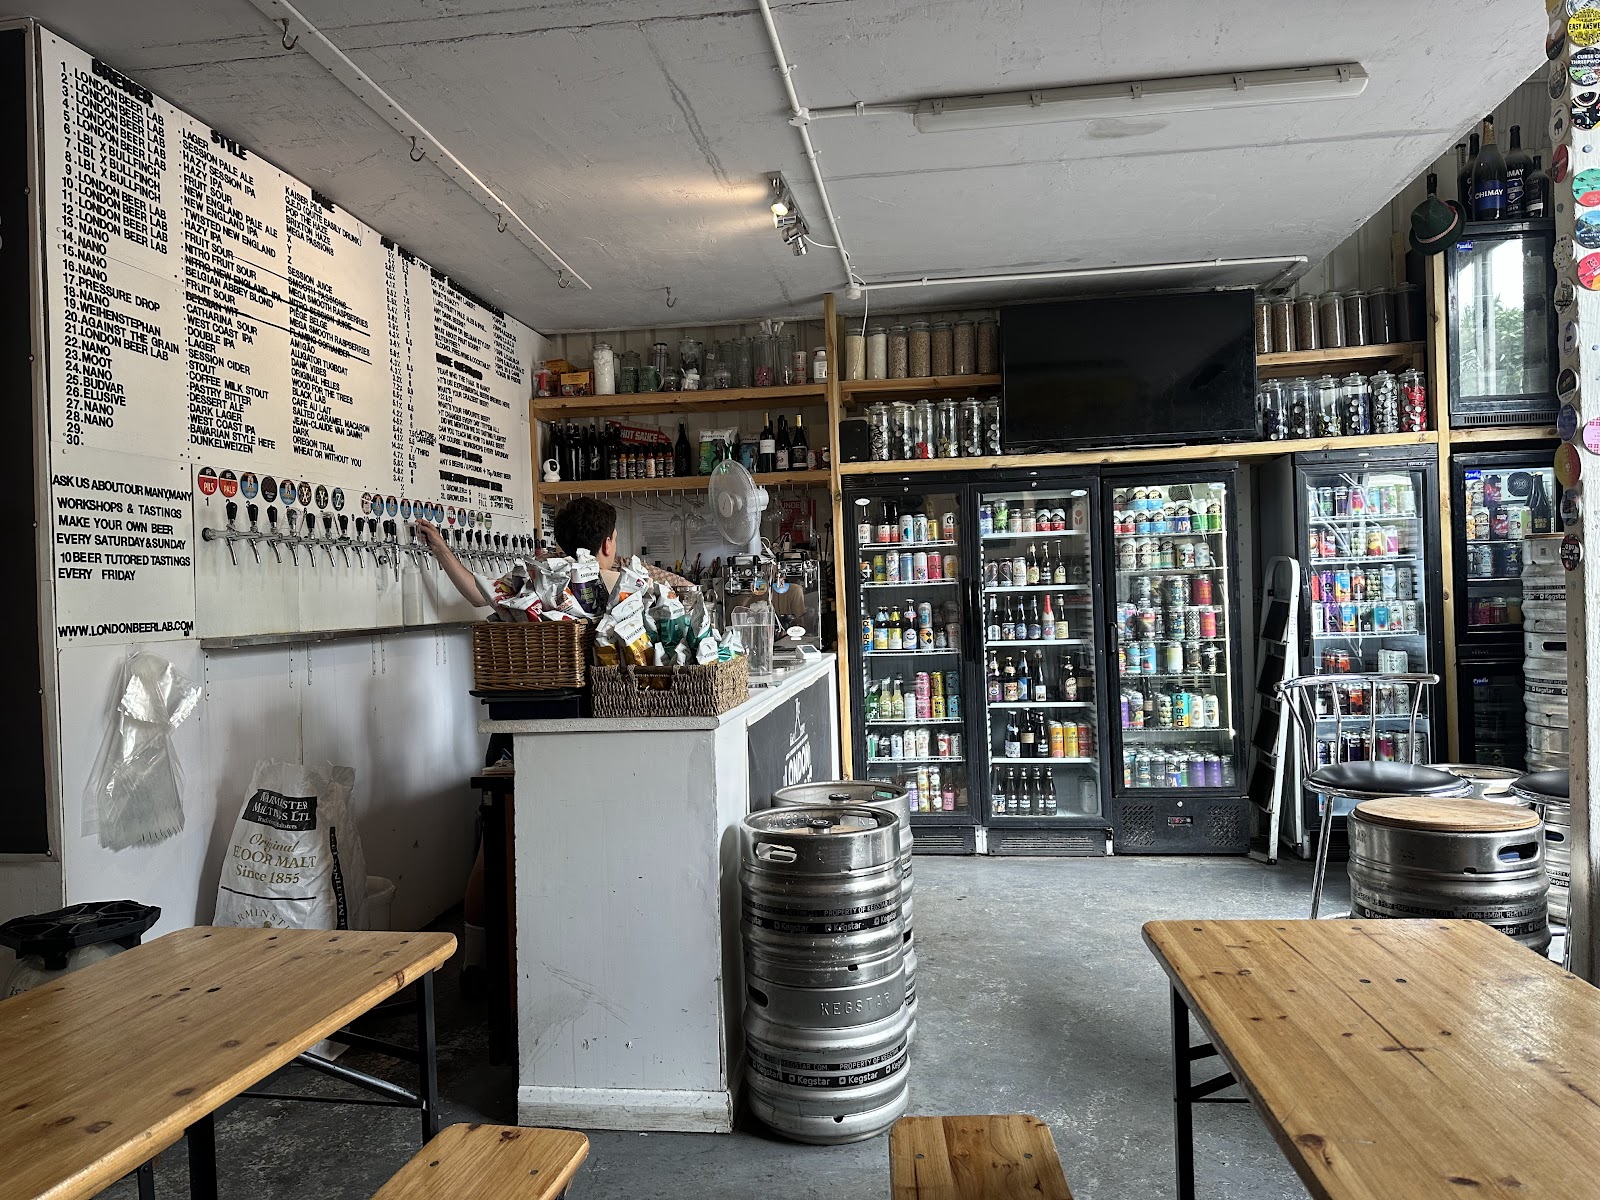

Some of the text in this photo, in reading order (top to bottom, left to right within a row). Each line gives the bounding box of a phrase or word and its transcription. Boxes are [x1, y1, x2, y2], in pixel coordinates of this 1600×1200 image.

[92, 58, 153, 108] BREWER
[75, 68, 164, 126] LONDON BEER LAB
[76, 79, 164, 137] LONDON BEER LAB
[76, 92, 165, 148] LONDON BEER LAB
[77, 103, 166, 159] LONDON BEER LAB
[77, 115, 166, 171] LONDON BEER LAB
[183, 128, 208, 150] LAGER
[211, 130, 247, 160] STYLE
[77, 130, 160, 179] LBL X BULLFINCH
[183, 140, 254, 186] SESSION PALE ALE
[78, 142, 160, 192] LBL X BULLFINCH
[1507, 169, 1524, 177] IMAY
[79, 155, 160, 203] LBL X BULLFINCH
[79, 171, 166, 219] LONDON BEER LAB
[1475, 189, 1503, 199] CHIMAY
[79, 183, 167, 231] LONDON BEER LAB
[184, 184, 277, 238] NEW ENGLAND PALE ALE
[79, 196, 167, 242] LONDON BEER LAB
[79, 209, 167, 254] LONDON BEER LAB
[184, 207, 276, 258] TWISTED NEW ENGLAND
[79, 276, 160, 312] PRESSURE DROP
[186, 266, 273, 308] BELGIAN ABBEY BLOND
[80, 301, 160, 337] WEIHENSTEPHAN
[81, 315, 179, 354] AGAINST THE GRAIN
[124, 339, 148, 355] BEER
[151, 347, 168, 360] LAB
[189, 349, 250, 375] SESSION CIDER
[189, 360, 216, 375] STOUT
[84, 376, 123, 394] BUDVAR
[190, 371, 269, 399] COFFEE MILK STOUT
[190, 382, 251, 406] PASTRY BITTER
[84, 388, 126, 406] ELUSIVE
[84, 400, 113, 415] NANO
[190, 392, 244, 412] DESSERT ALE
[84, 413, 113, 428] NANO
[190, 403, 242, 422] DARK LAGER
[190, 414, 255, 435] WEST COAST IPA
[620, 429, 658, 442] HOT SAUCE
[191, 424, 275, 449] BAVARIAN STYLE HEFE
[191, 434, 253, 453] DUNKELWEIZEN
[52, 475, 74, 487] ASK
[76, 477, 89, 488] US
[204, 482, 214, 492] PILS
[57, 497, 182, 519] WORKSHOPS & TASTINGS
[59, 515, 173, 535] MAKE YOUR OWN BEER
[57, 533, 91, 544] EVERY
[105, 554, 149, 565] TUTORED
[150, 556, 190, 566] TASTINGS
[58, 568, 135, 580] EVERY FRIDAY
[58, 621, 193, 637] WWW.LONDONBEERLAB.COM
[250, 833, 299, 852] Original
[274, 856, 316, 868] MALT
[236, 864, 299, 884] Since 1855
[833, 923, 861, 932] Kegstar
[821, 992, 890, 1015] KEGSTAR
[840, 1060, 871, 1070] PROPERTY
[798, 1076, 830, 1086] Kegstar
[849, 1072, 878, 1084] Kegstar
